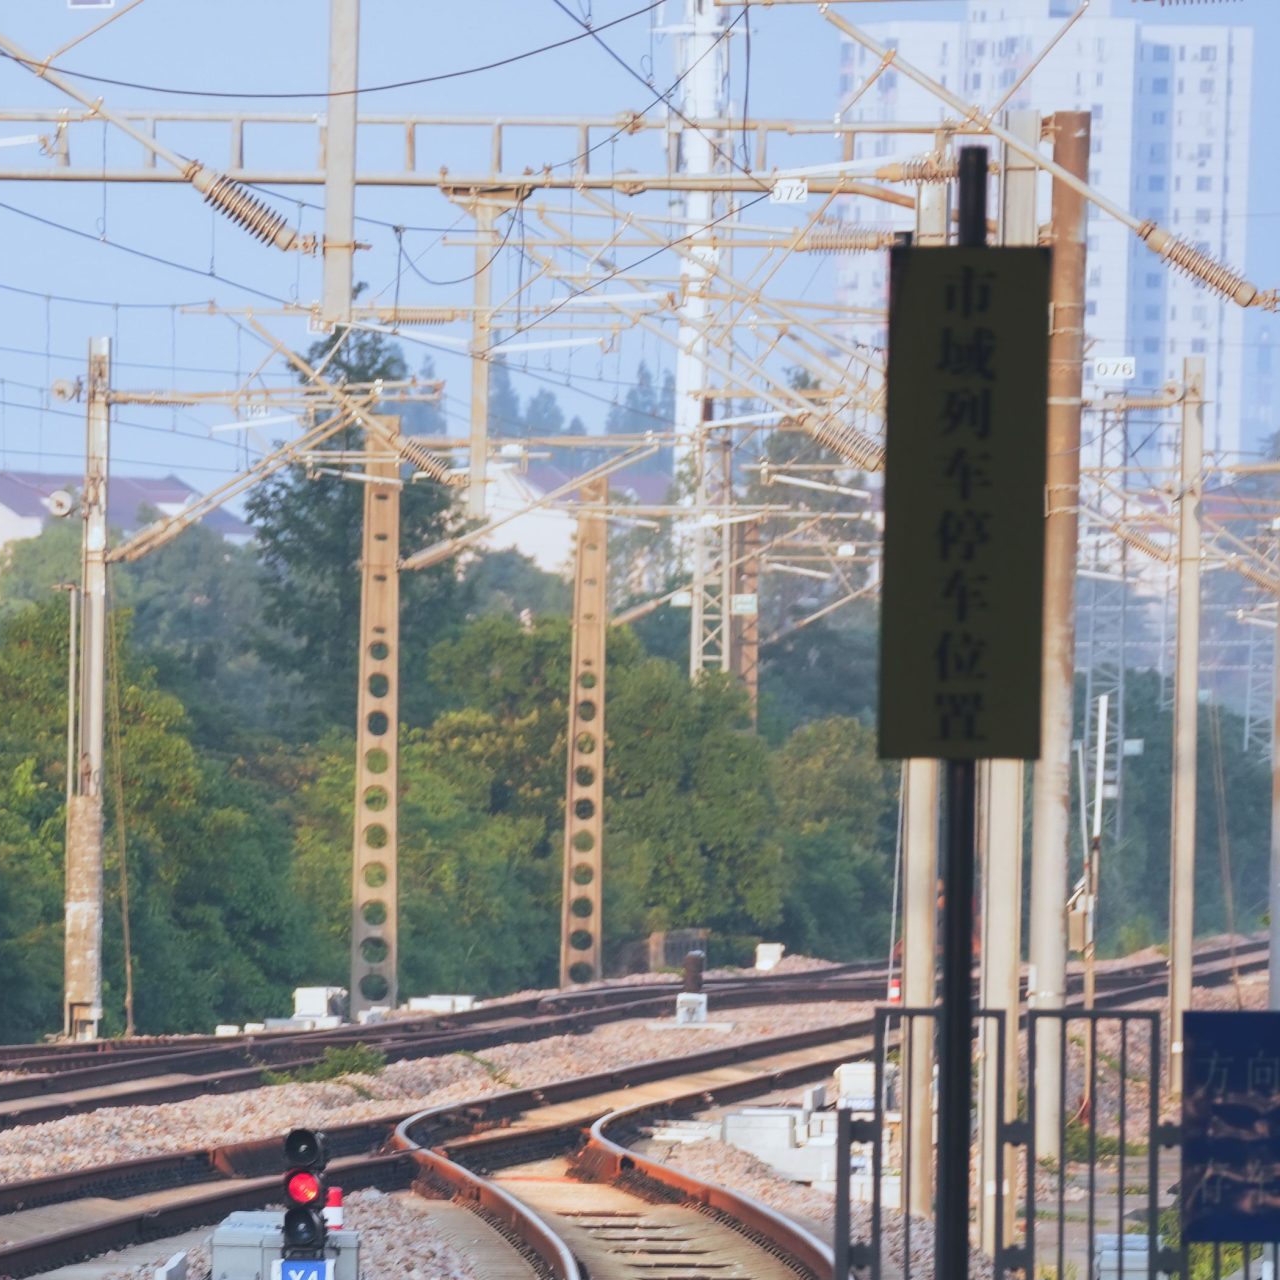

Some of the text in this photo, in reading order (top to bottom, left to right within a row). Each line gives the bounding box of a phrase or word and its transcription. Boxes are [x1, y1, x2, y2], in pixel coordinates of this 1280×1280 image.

[1096, 361, 1133, 377] 076
[932, 264, 997, 743] 市域列车停车位置
